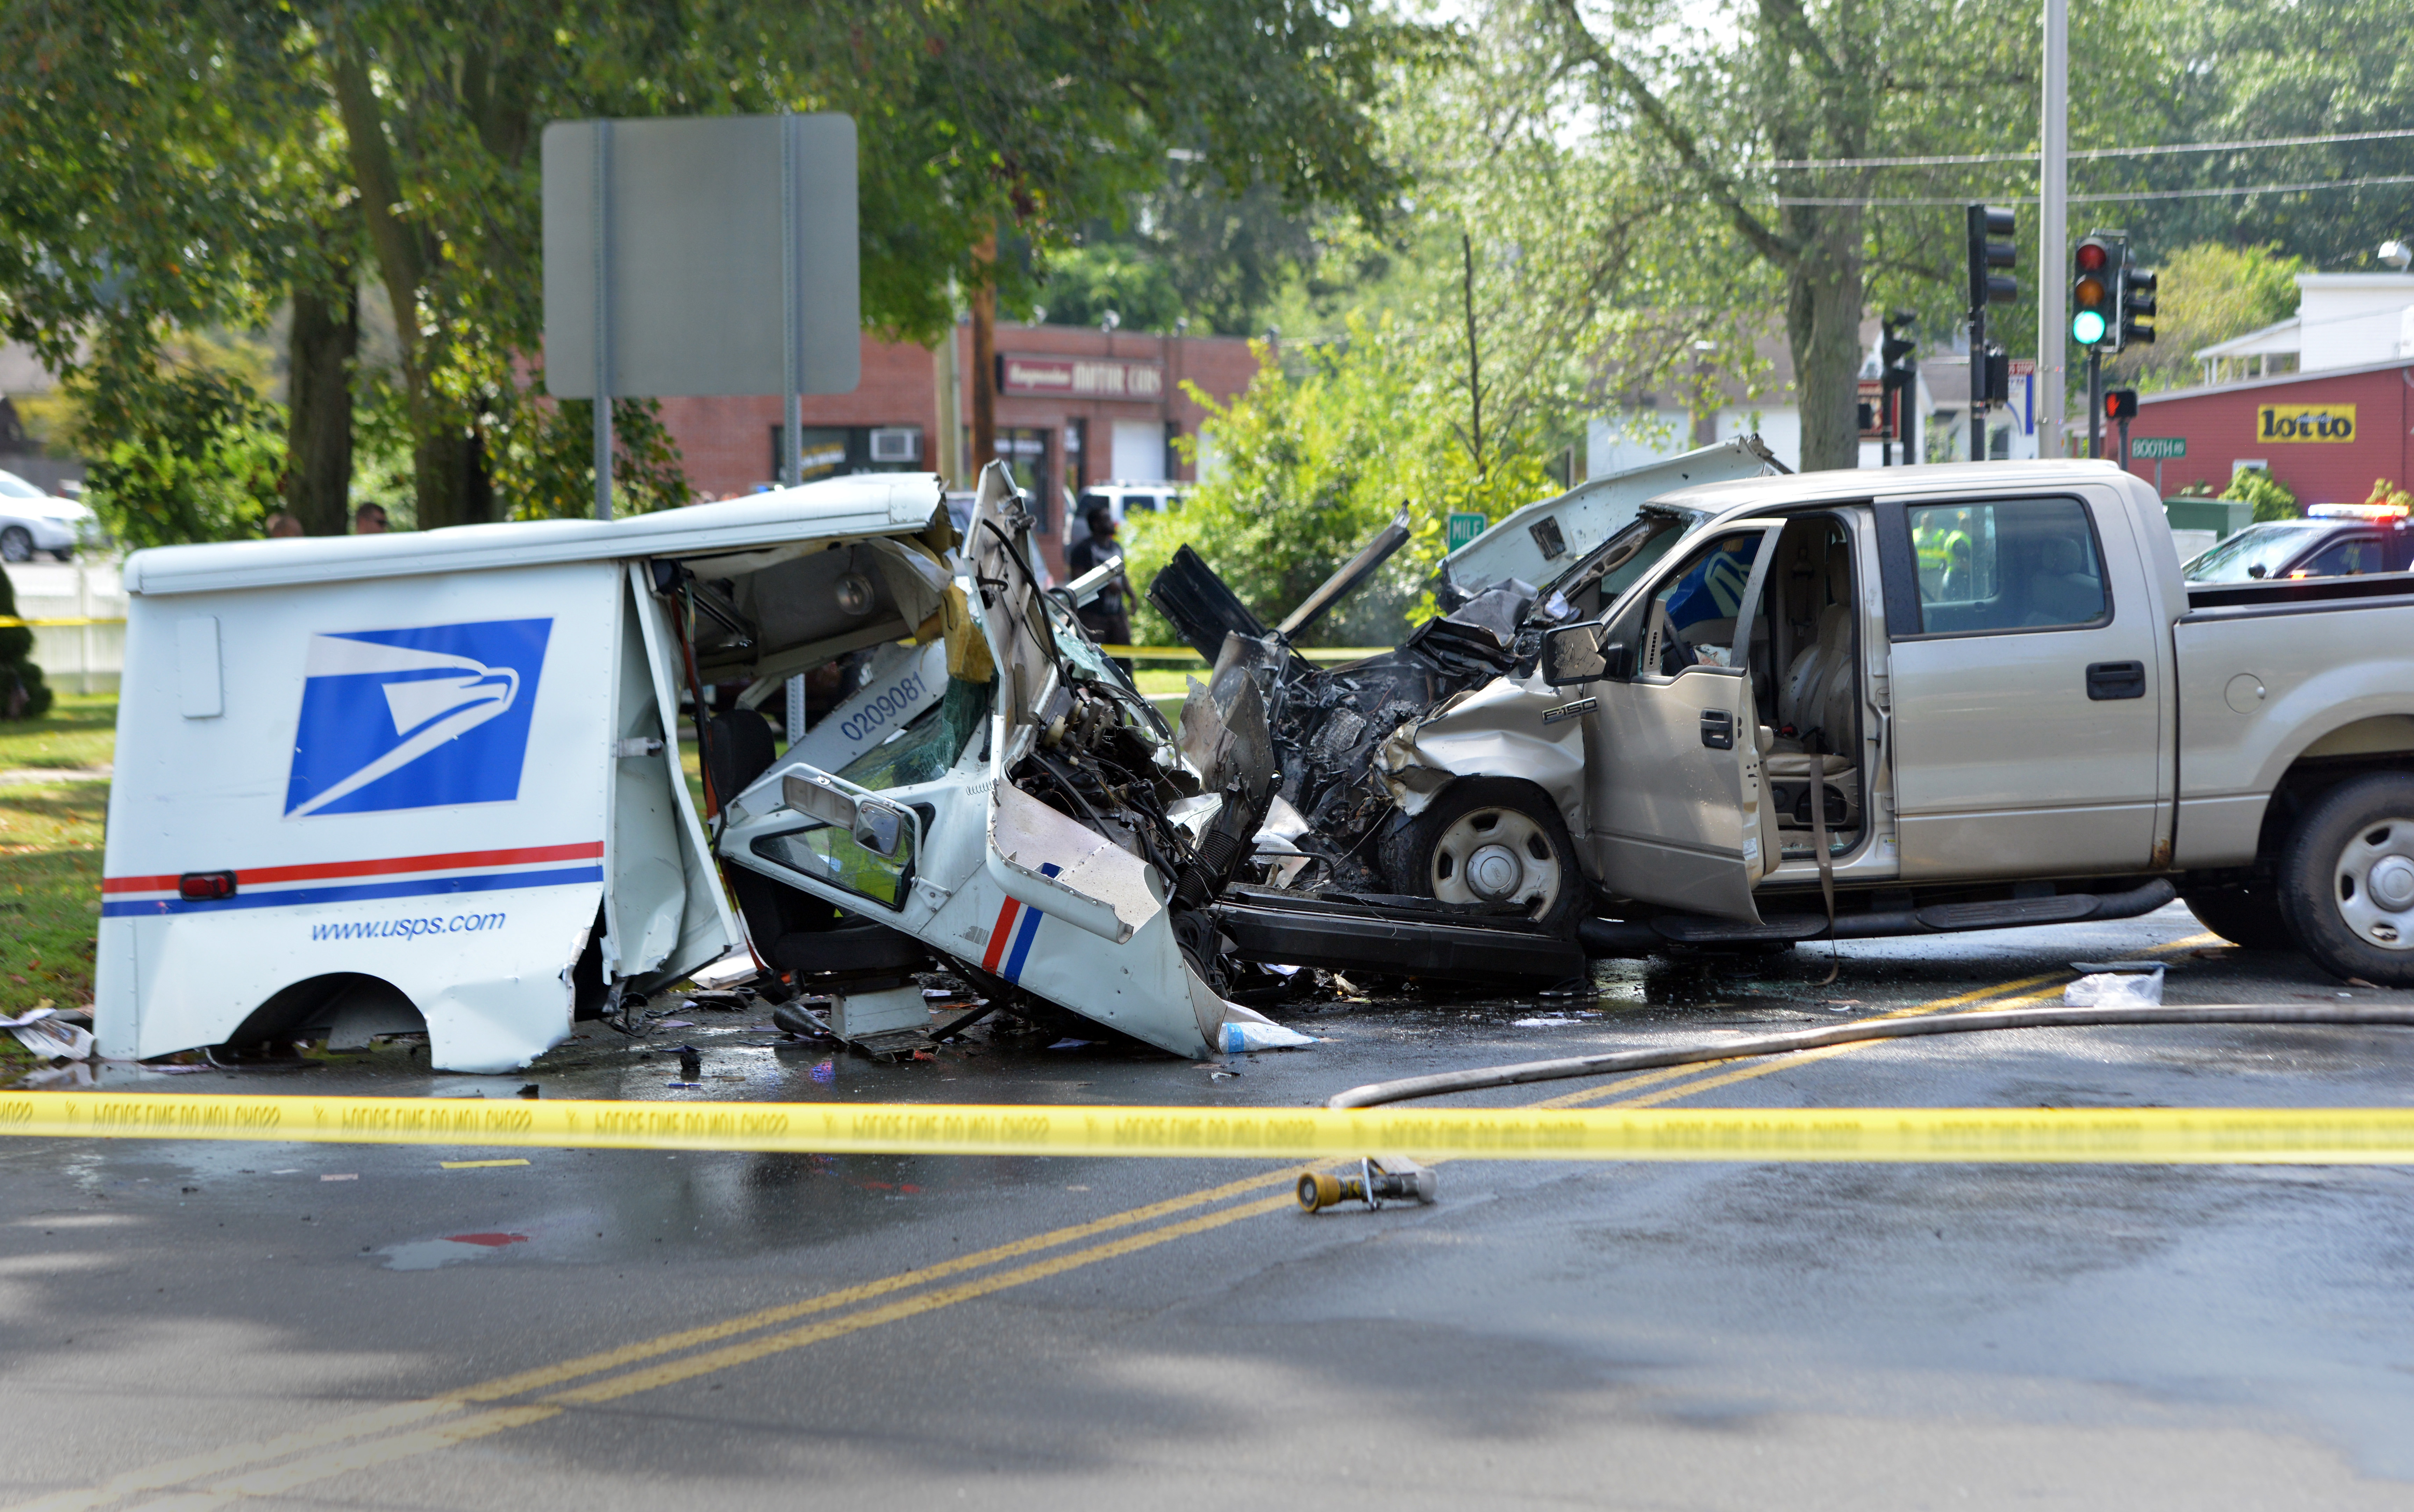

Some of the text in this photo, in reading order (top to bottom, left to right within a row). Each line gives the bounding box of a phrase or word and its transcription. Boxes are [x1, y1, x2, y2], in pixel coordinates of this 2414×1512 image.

[2262, 409, 2352, 437] lotto
[2132, 439, 2173, 457] BOOTH
[1452, 520, 1481, 540] MILE
[841, 671, 927, 741] 0209081
[1544, 699, 1597, 720] F-150
[312, 912, 506, 941] www.usps.com
